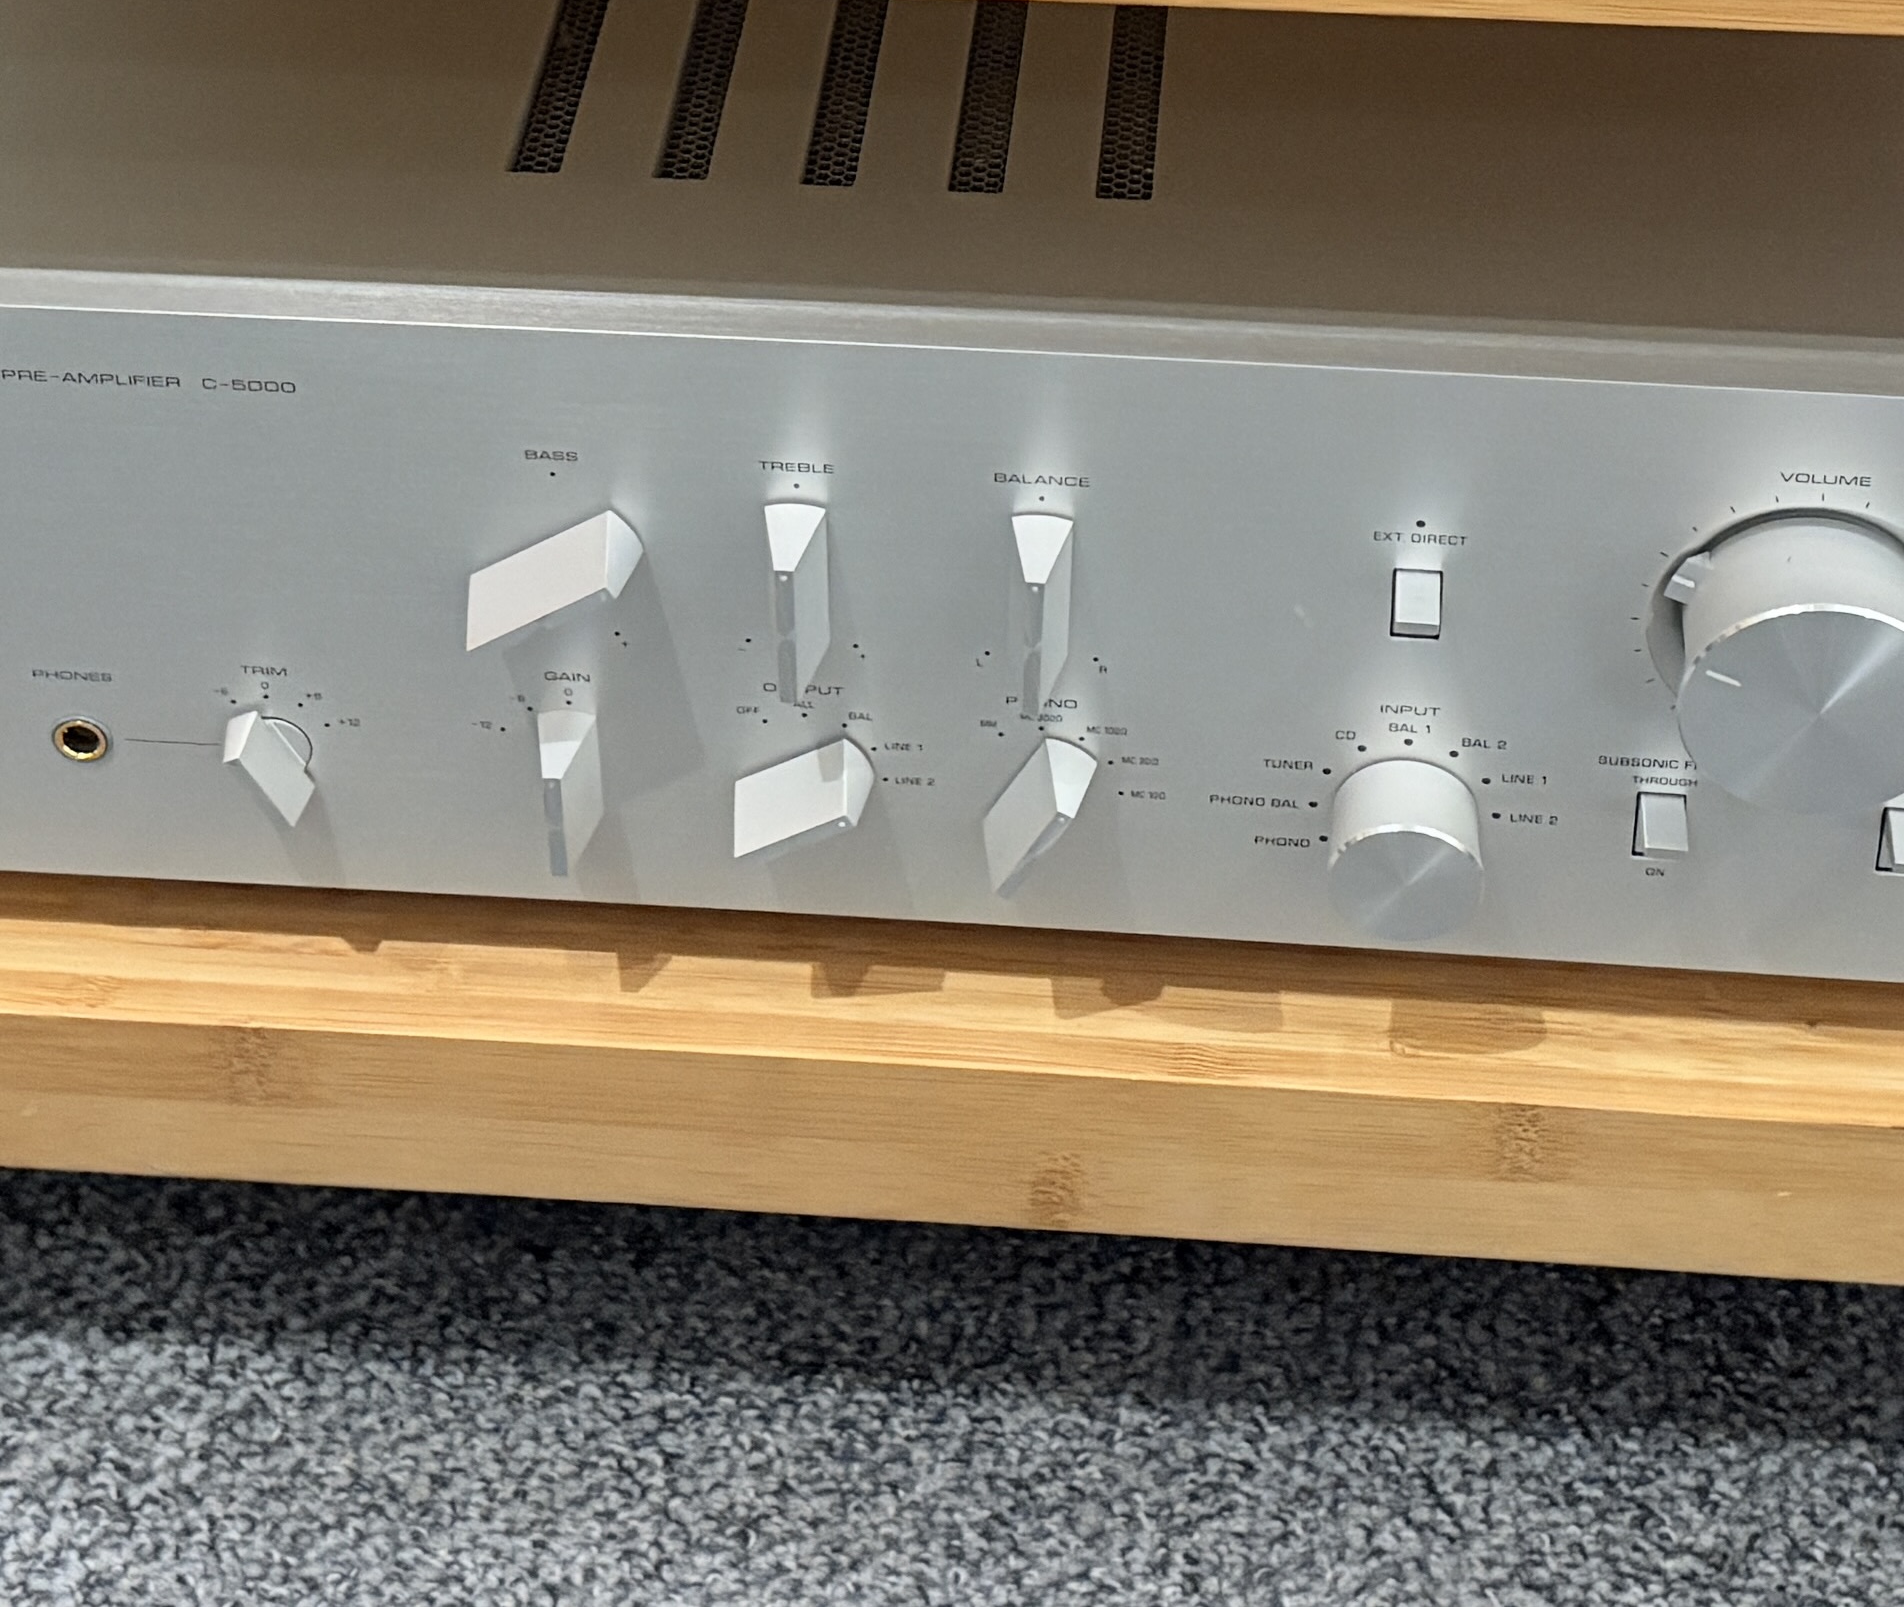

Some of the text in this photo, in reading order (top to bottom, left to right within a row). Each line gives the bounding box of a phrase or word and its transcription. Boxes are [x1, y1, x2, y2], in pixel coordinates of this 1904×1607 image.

[1, 369, 181, 389] PRE-AMPLIFIER
[202, 378, 297, 394] C-5000
[524, 449, 578, 462] BASS
[758, 460, 834, 474] TREBLE
[994, 472, 1090, 488] BALANCE
[1780, 472, 1872, 487] VOLUME
[1411, 533, 1468, 546] DIRECT
[32, 669, 113, 683] PHONES
[240, 665, 288, 678] TRIM
[544, 671, 591, 683] GAIN
[848, 711, 873, 722] BAL
[1380, 705, 1441, 717] INPUT
[1389, 723, 1418, 734] BAL
[1335, 730, 1356, 741] CD
[1462, 738, 1508, 750] BAL 2
[1263, 758, 1314, 771] TUNER
[1598, 755, 1680, 770] SUBSONIC
[1502, 774, 1535, 785] LINE
[1633, 775, 1698, 787] THROUGH
[1209, 794, 1300, 809] PHONO BAL
[1510, 814, 1559, 826] LINE 2
[1254, 835, 1310, 848] PHONO
[1645, 867, 1666, 877] ON
